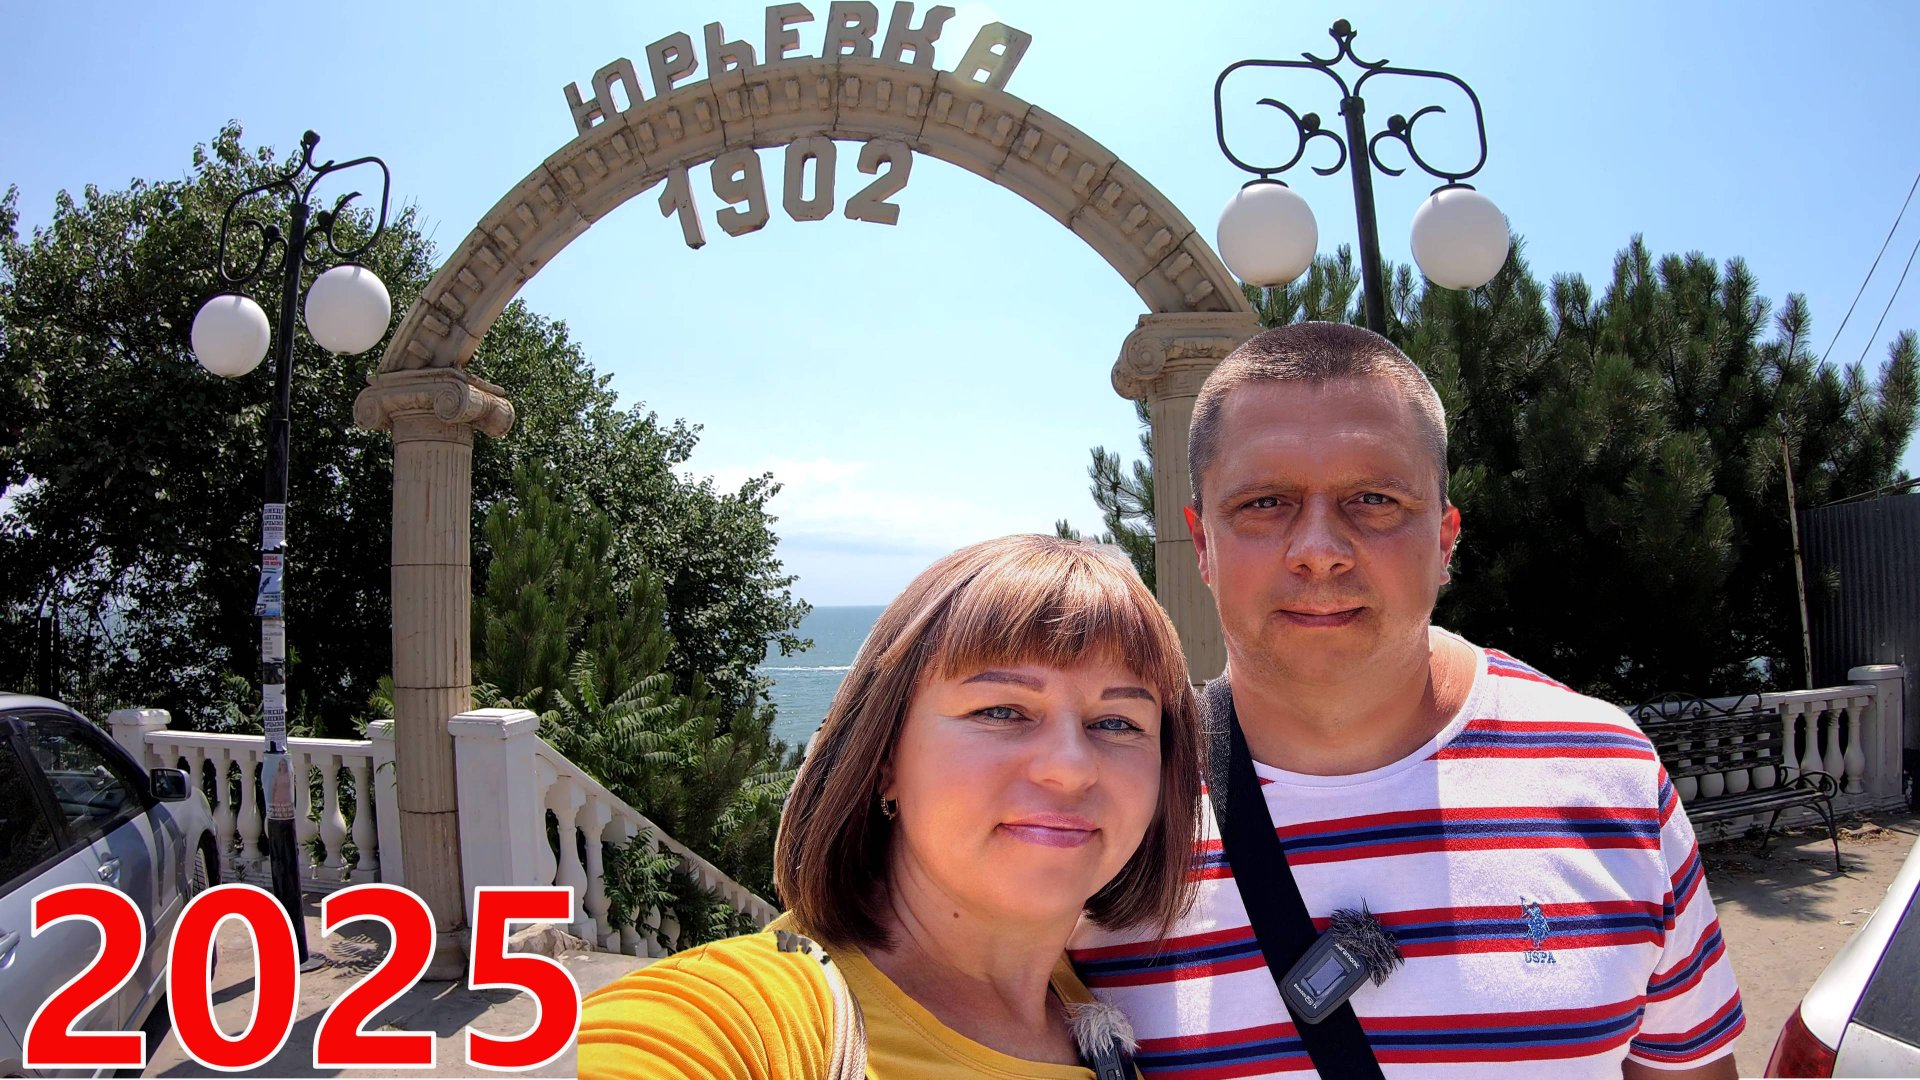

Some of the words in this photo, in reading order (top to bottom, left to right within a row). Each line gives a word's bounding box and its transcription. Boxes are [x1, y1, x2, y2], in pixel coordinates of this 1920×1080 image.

[563, 0, 1033, 137] ЮРЬЕВКА
[658, 136, 914, 250] 1902
[1523, 950, 1557, 964] USPA
